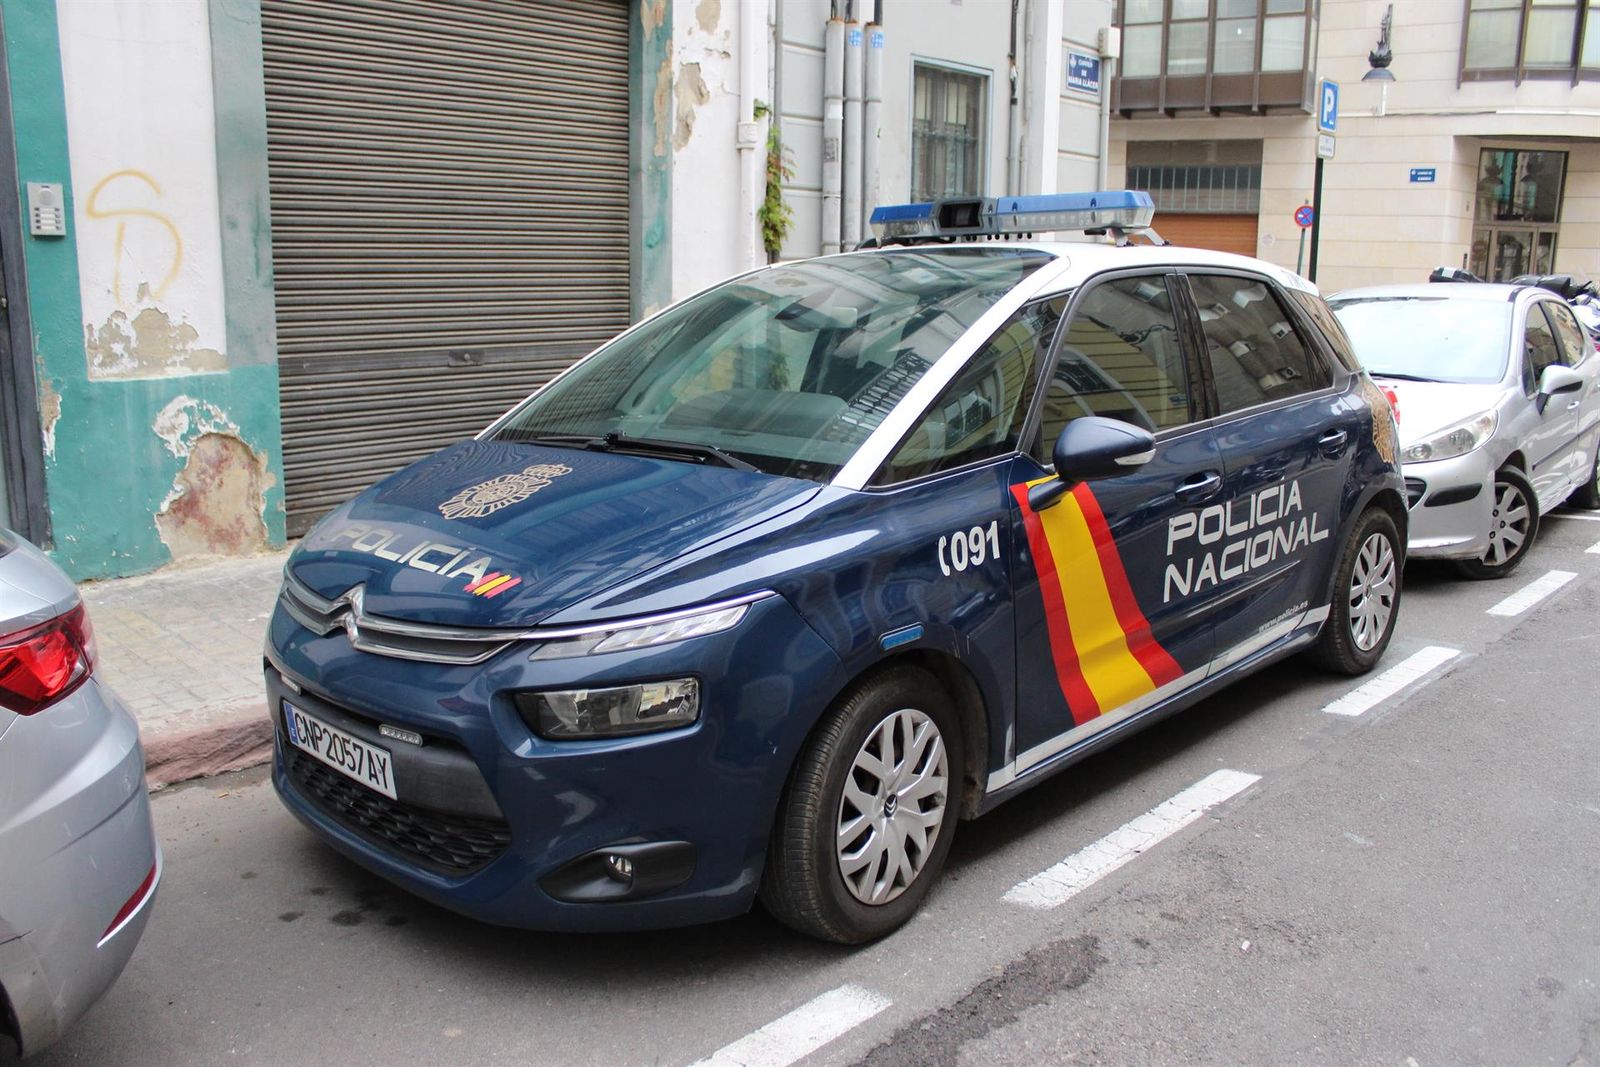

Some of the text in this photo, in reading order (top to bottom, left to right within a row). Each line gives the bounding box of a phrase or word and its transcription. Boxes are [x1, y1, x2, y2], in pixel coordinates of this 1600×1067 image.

[1323, 88, 1335, 123] P
[950, 520, 1001, 573] 091
[1166, 475, 1303, 557] POLICÍA
[329, 523, 492, 586] POLICÍA
[1162, 511, 1330, 604] NACIONAL
[294, 712, 388, 789] CNP2057AY
